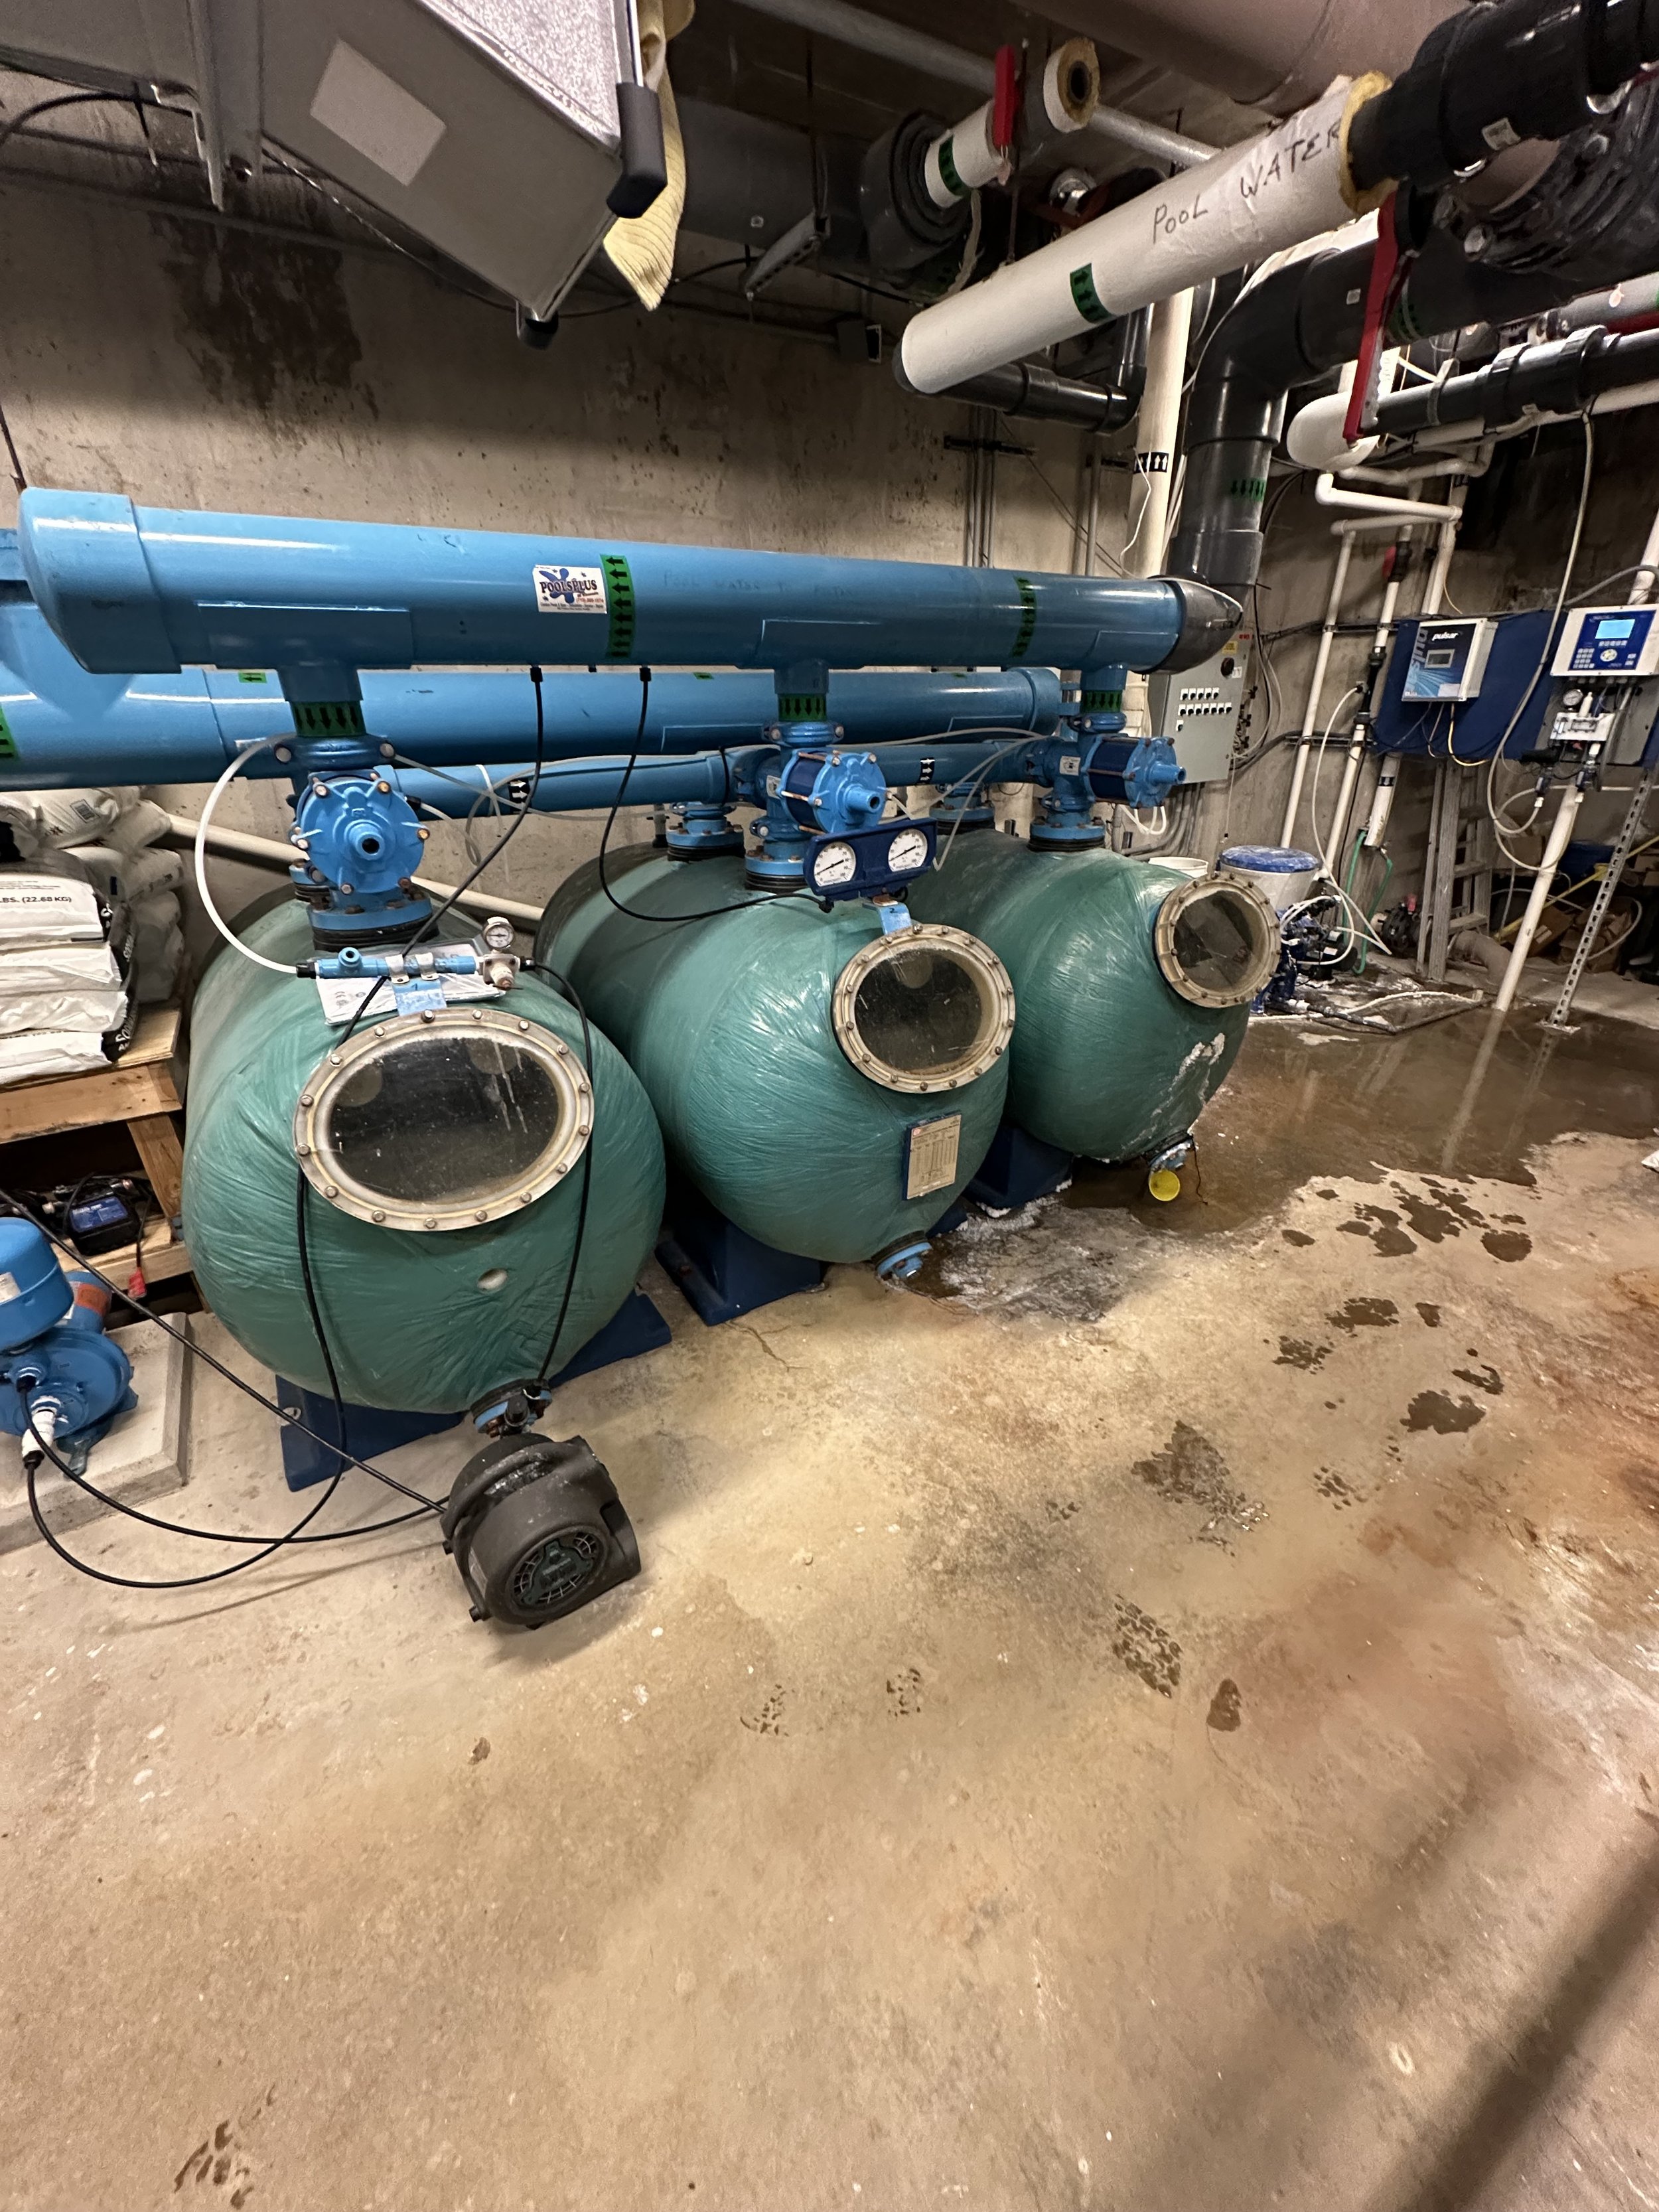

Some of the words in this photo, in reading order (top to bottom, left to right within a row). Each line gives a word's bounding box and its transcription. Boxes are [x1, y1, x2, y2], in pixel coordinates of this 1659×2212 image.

[1153, 194, 1208, 244] POOL
[1240, 117, 1341, 198] WATER
[1431, 631, 1459, 642] pulsar
